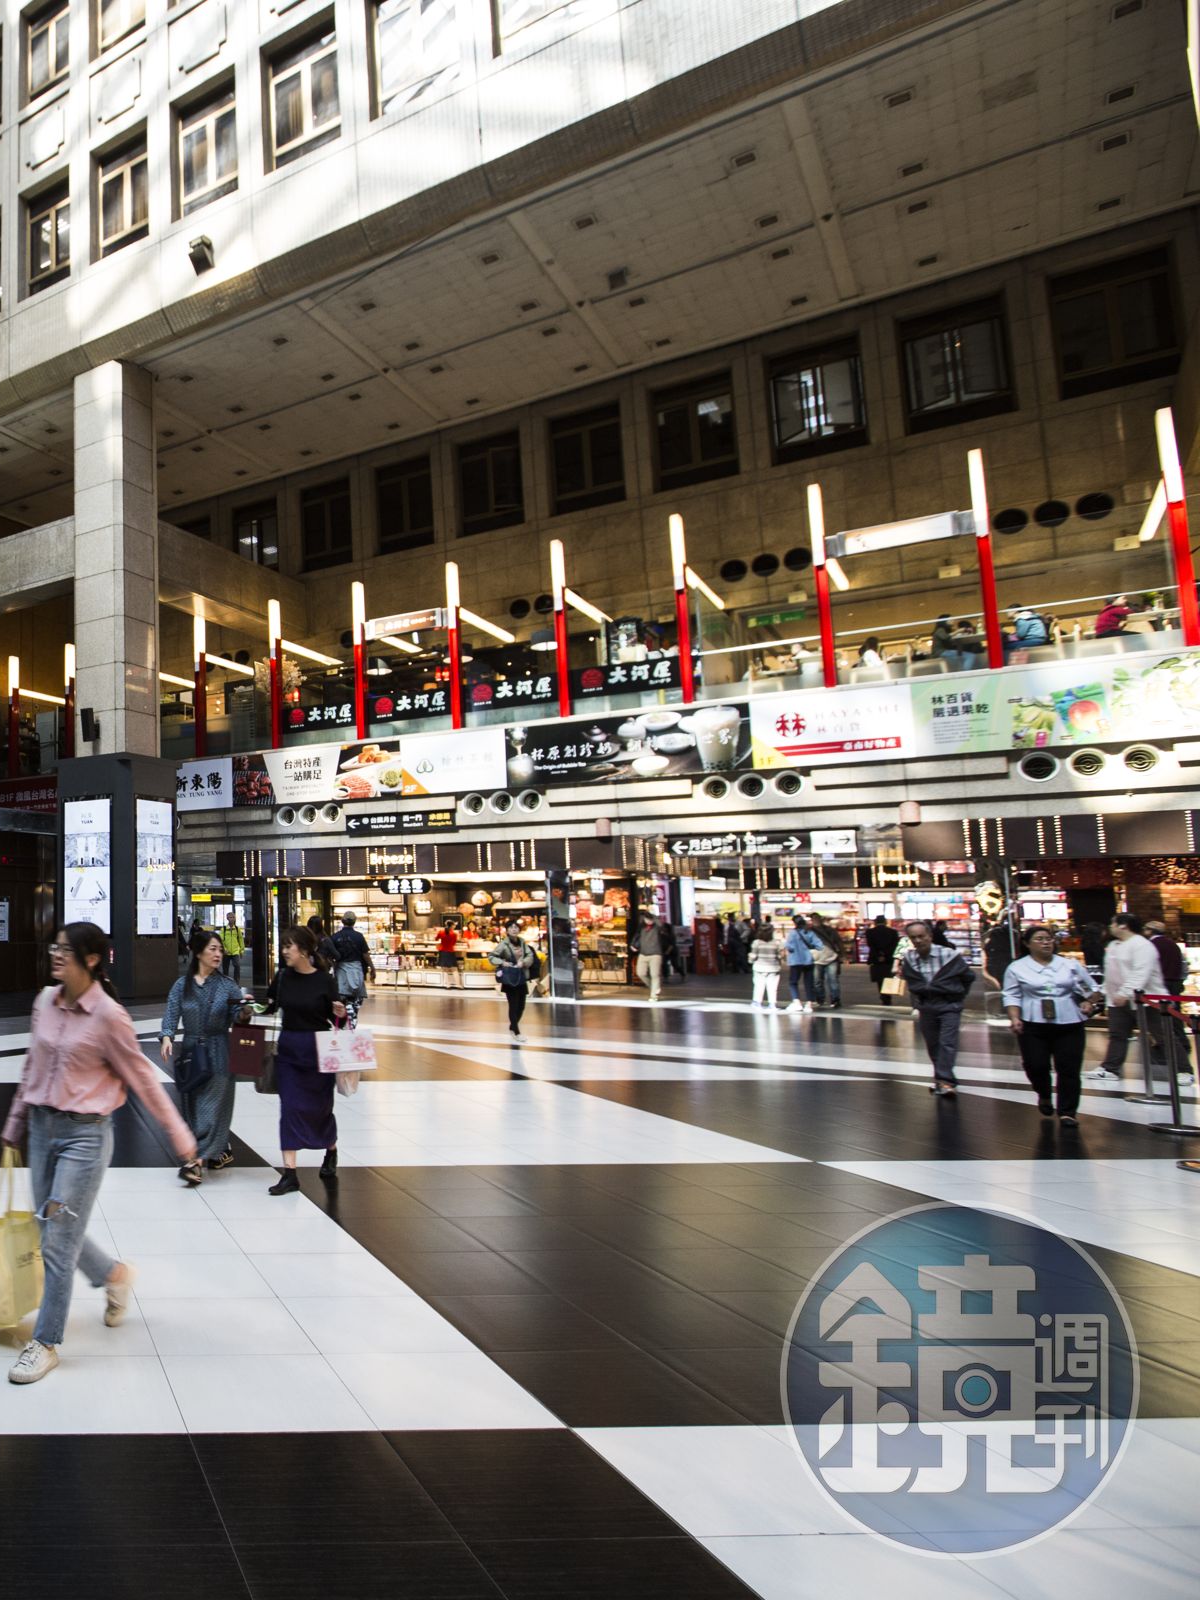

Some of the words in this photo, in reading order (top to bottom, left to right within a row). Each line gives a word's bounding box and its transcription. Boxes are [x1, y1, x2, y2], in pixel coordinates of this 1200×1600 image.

[608, 660, 671, 684] 大河屋
[495, 676, 552, 698] 大河屋
[396, 691, 446, 711] 大河屋
[931, 691, 973, 705] 林百貨
[307, 704, 352, 722] 大河屋
[176, 772, 222, 793] 新東陽
[404, 784, 418, 793] 2F
[369, 852, 414, 866] Breeze
